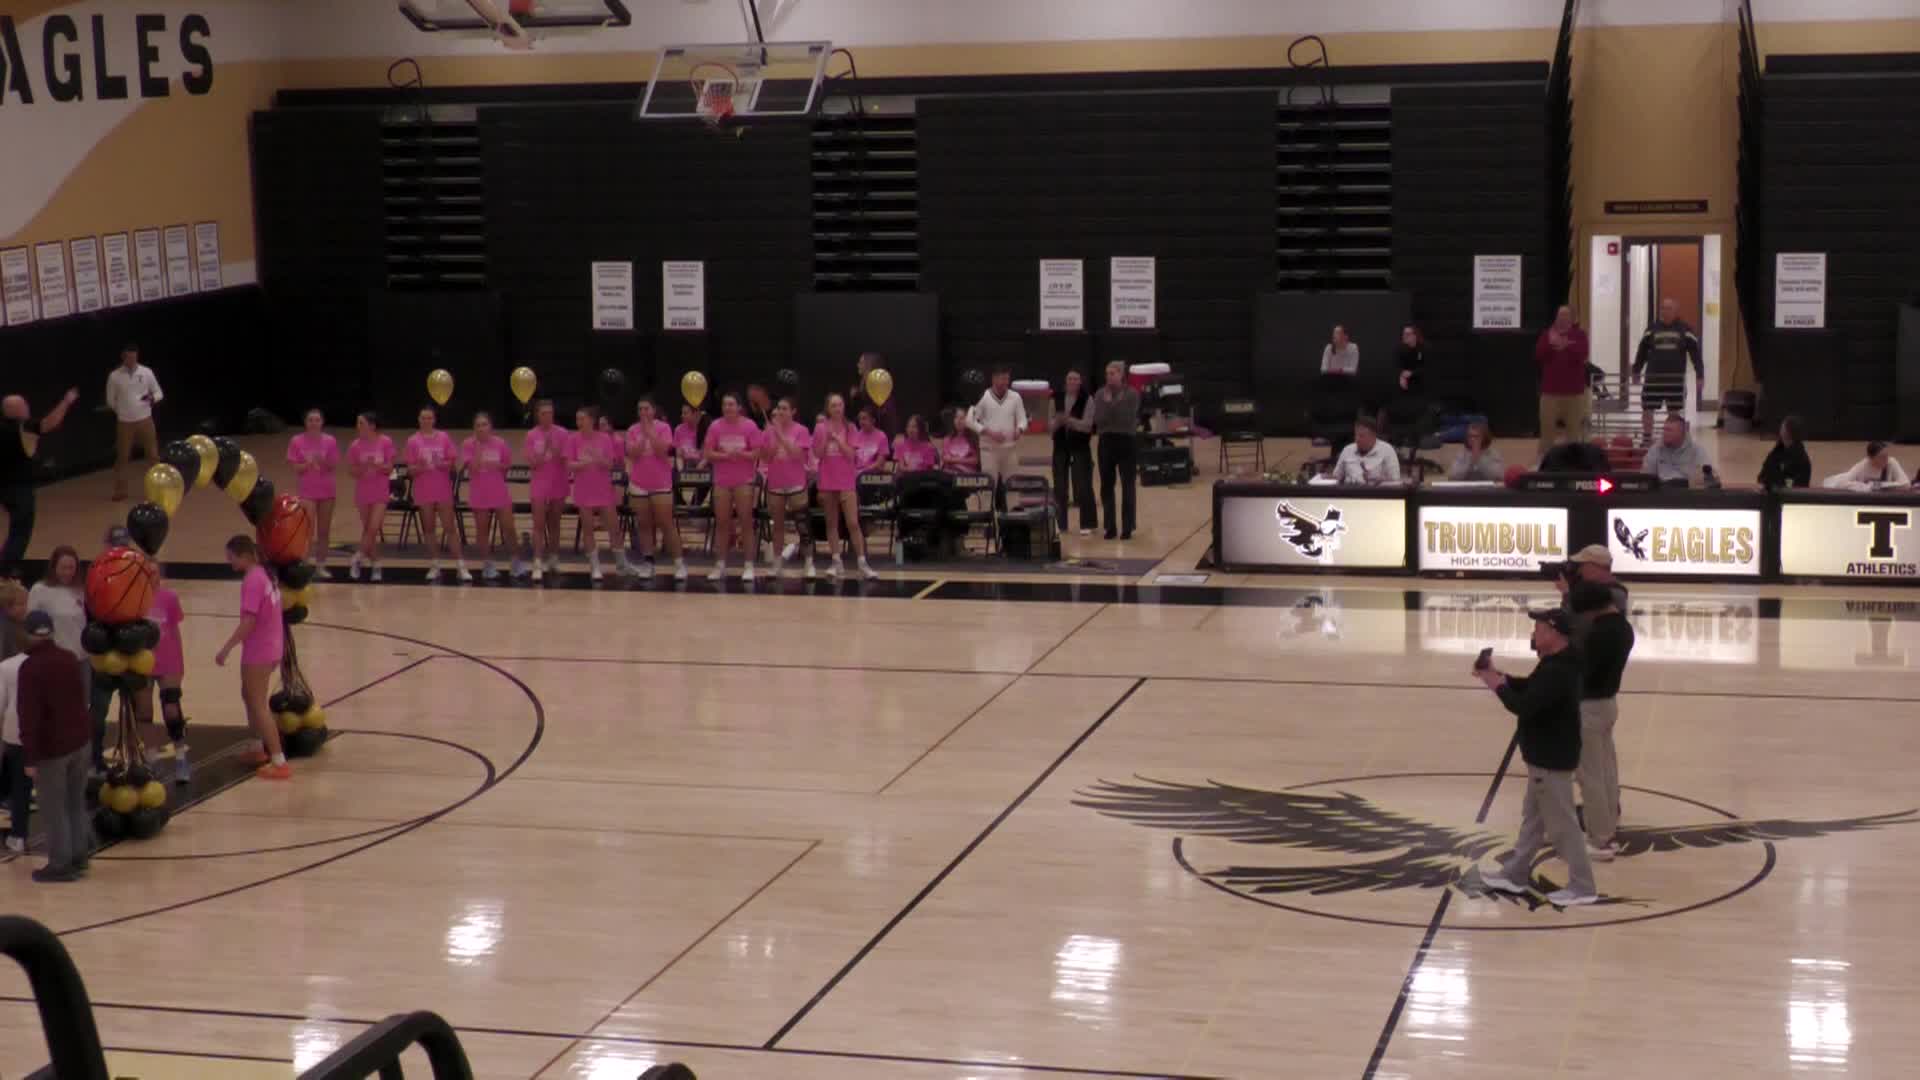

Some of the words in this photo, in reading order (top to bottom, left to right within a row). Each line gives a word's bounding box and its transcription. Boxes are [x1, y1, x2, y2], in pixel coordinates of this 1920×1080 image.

[1424, 521, 1562, 555] TRUMBULL
[1652, 526, 1753, 563] EAGLES
[1450, 556, 1479, 567] HIGH
[1483, 556, 1530, 567] SCHOOL
[1846, 562, 1917, 576] ATHLETICS
